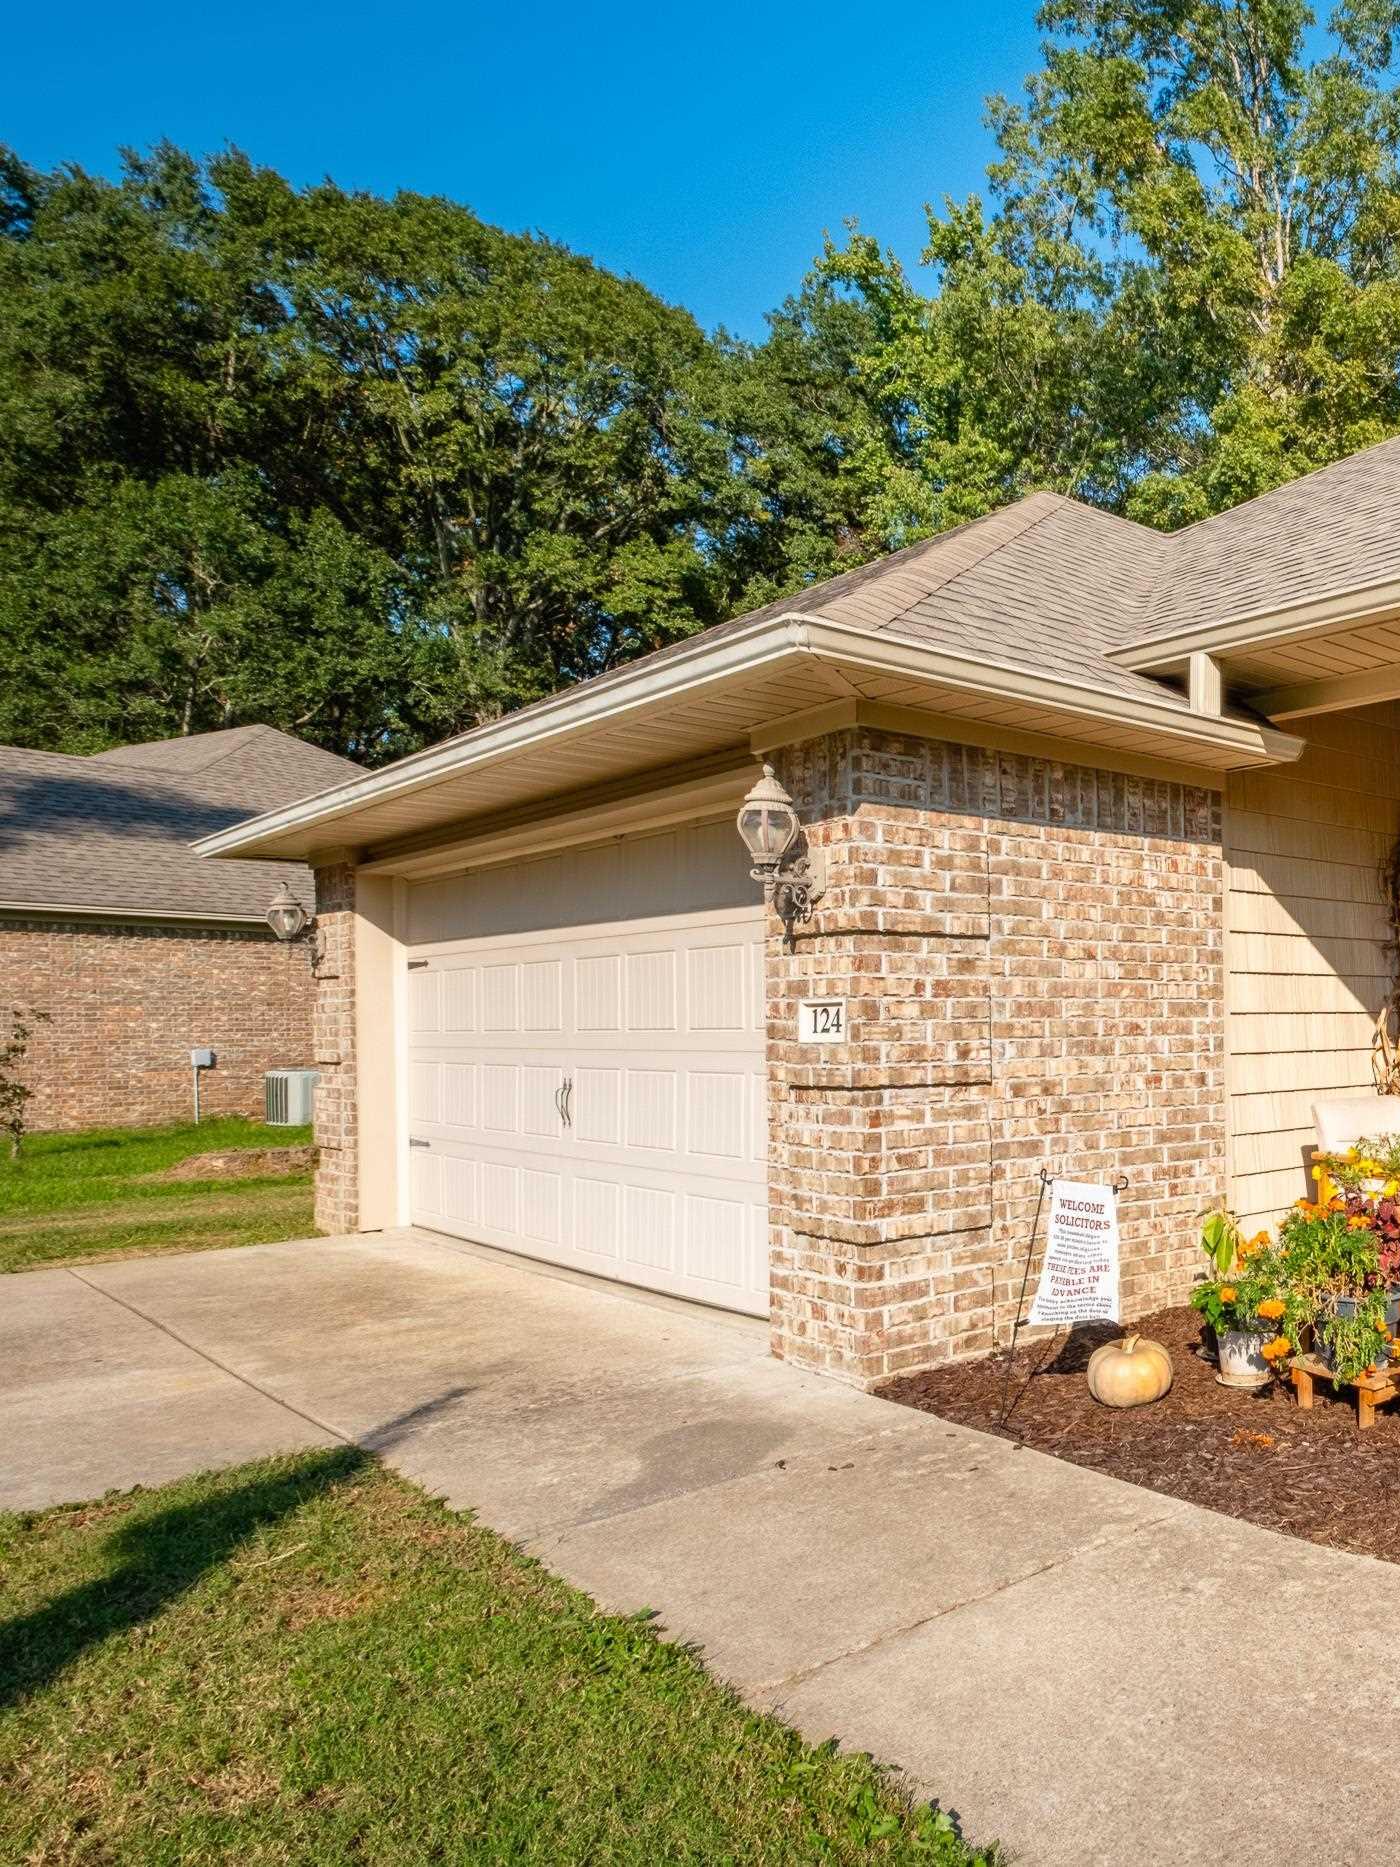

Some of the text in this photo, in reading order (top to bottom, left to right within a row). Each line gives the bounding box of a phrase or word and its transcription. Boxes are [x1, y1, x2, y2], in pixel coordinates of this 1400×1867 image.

[813, 1008, 842, 1033] 124
[1059, 1198, 1105, 1215] WELCOME
[1054, 1214, 1111, 1231] SOLICITORS
[1089, 1264, 1111, 1273] ARE
[1088, 1275, 1100, 1283] IN
